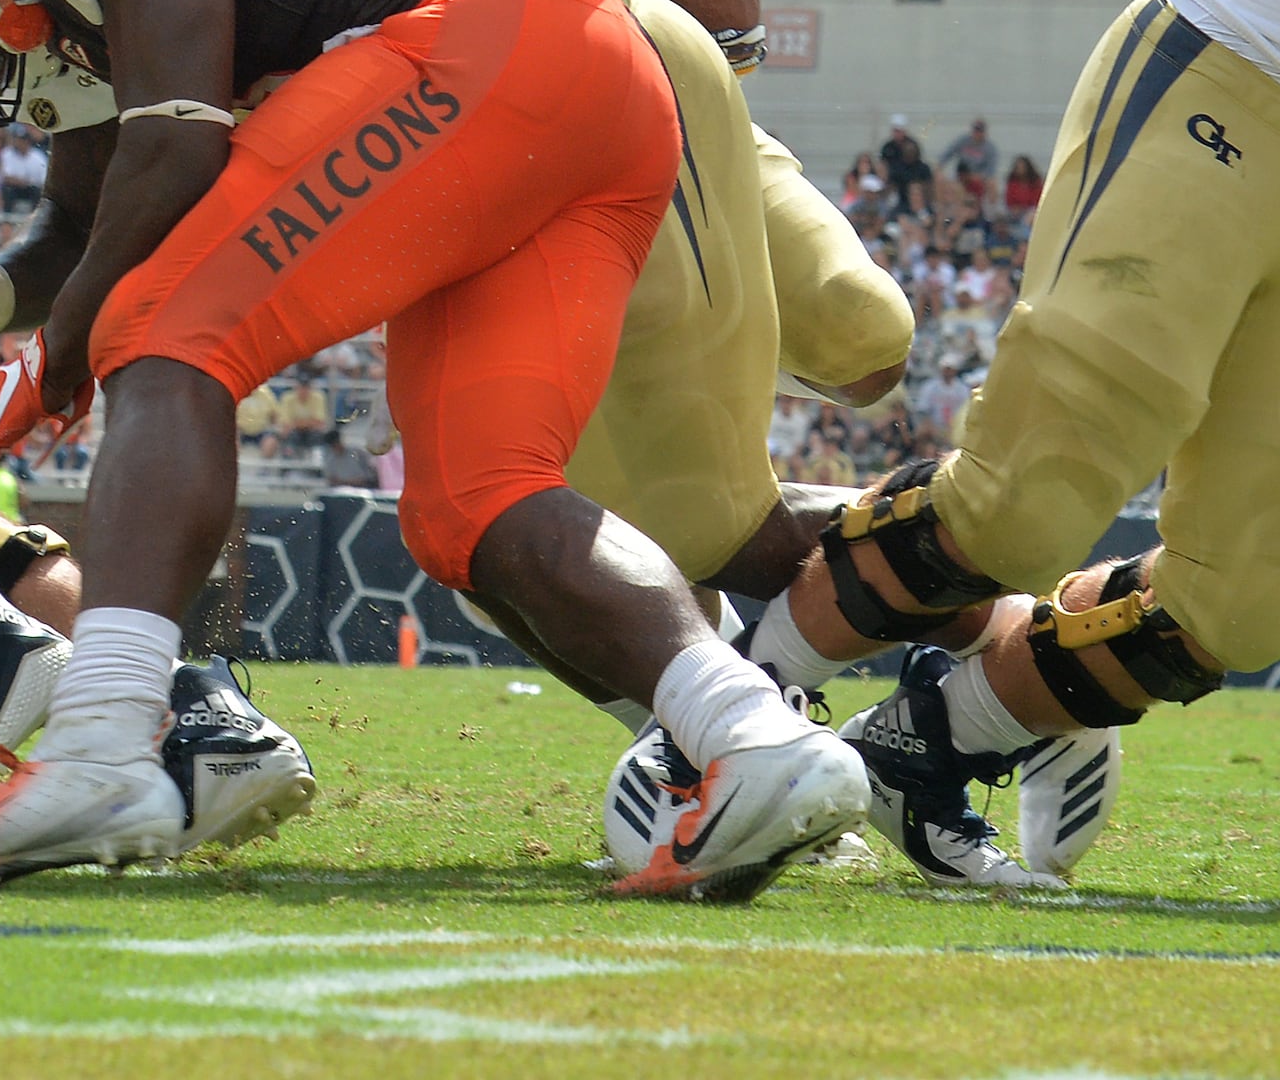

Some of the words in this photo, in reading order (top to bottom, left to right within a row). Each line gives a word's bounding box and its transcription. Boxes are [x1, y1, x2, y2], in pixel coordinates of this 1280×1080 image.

[1186, 112, 1243, 169] GT
[240, 78, 462, 275] FALCONS
[180, 708, 258, 735] adidas
[864, 725, 928, 754] adidas
